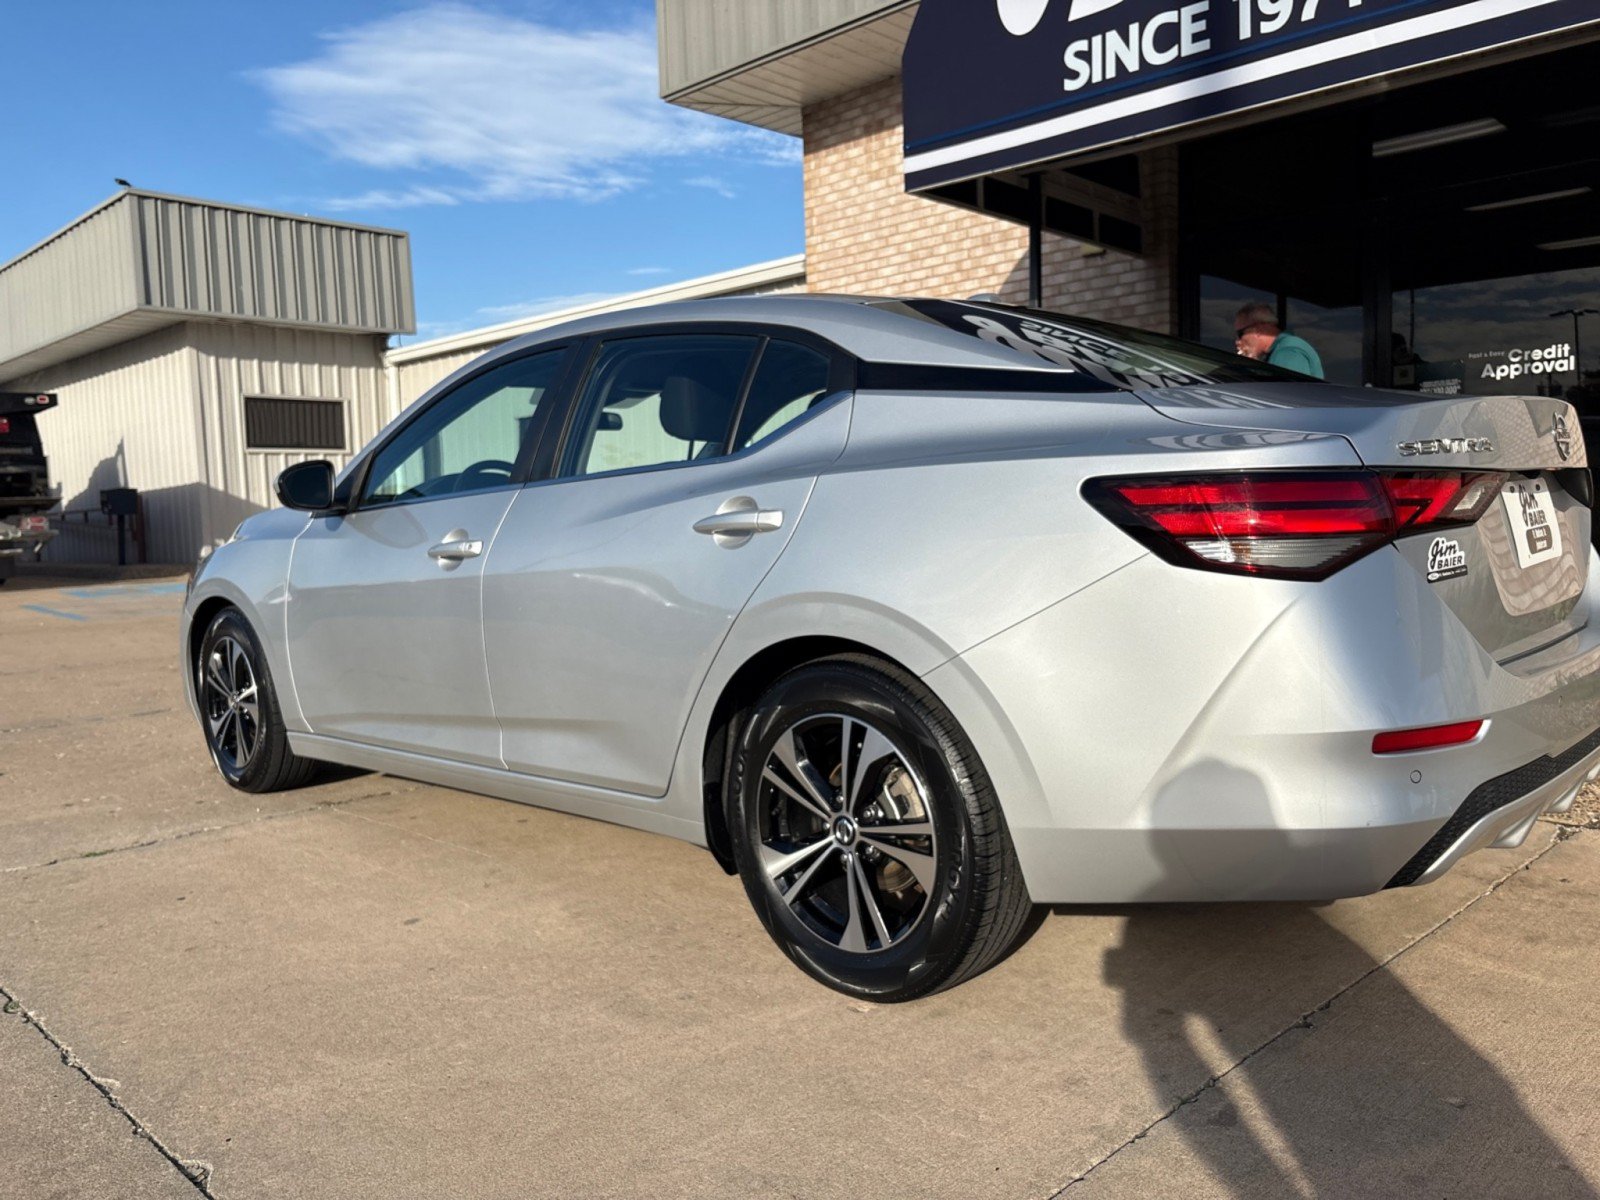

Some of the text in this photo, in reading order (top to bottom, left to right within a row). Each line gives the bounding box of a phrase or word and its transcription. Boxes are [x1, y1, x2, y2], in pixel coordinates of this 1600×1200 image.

[1063, 1, 1211, 91] SINCE
[1232, 0, 1362, 41] 19
[1508, 343, 1571, 363] Credit
[1481, 355, 1575, 381] Approval
[1396, 437, 1494, 457] SENTRA
[1430, 540, 1457, 570] Jim
[1437, 556, 1463, 569] BAIER
